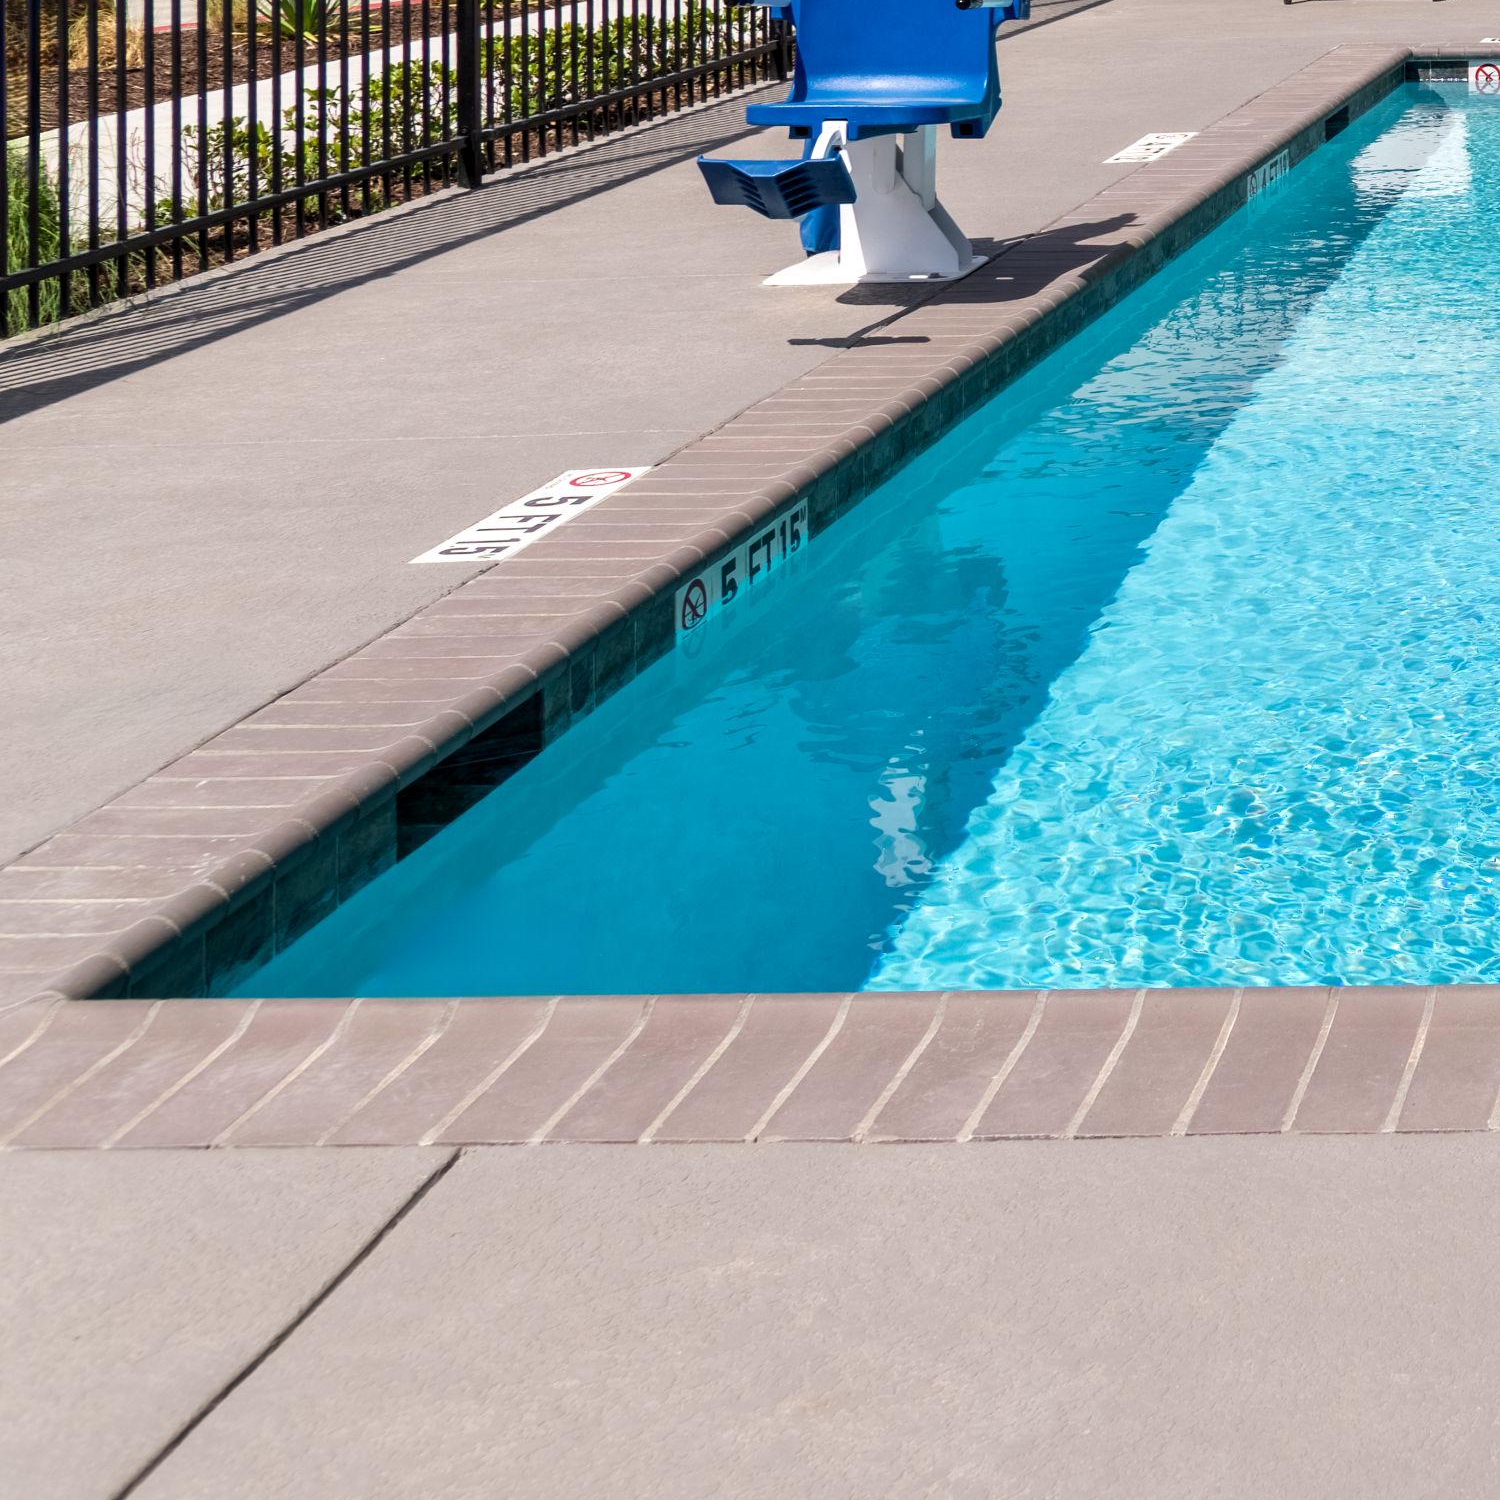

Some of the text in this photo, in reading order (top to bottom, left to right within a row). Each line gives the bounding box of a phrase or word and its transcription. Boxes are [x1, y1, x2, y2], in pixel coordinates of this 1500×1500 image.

[524, 495, 594, 507] 5
[476, 513, 563, 534] FT
[721, 557, 738, 605] 5
[749, 528, 776, 585] FT
